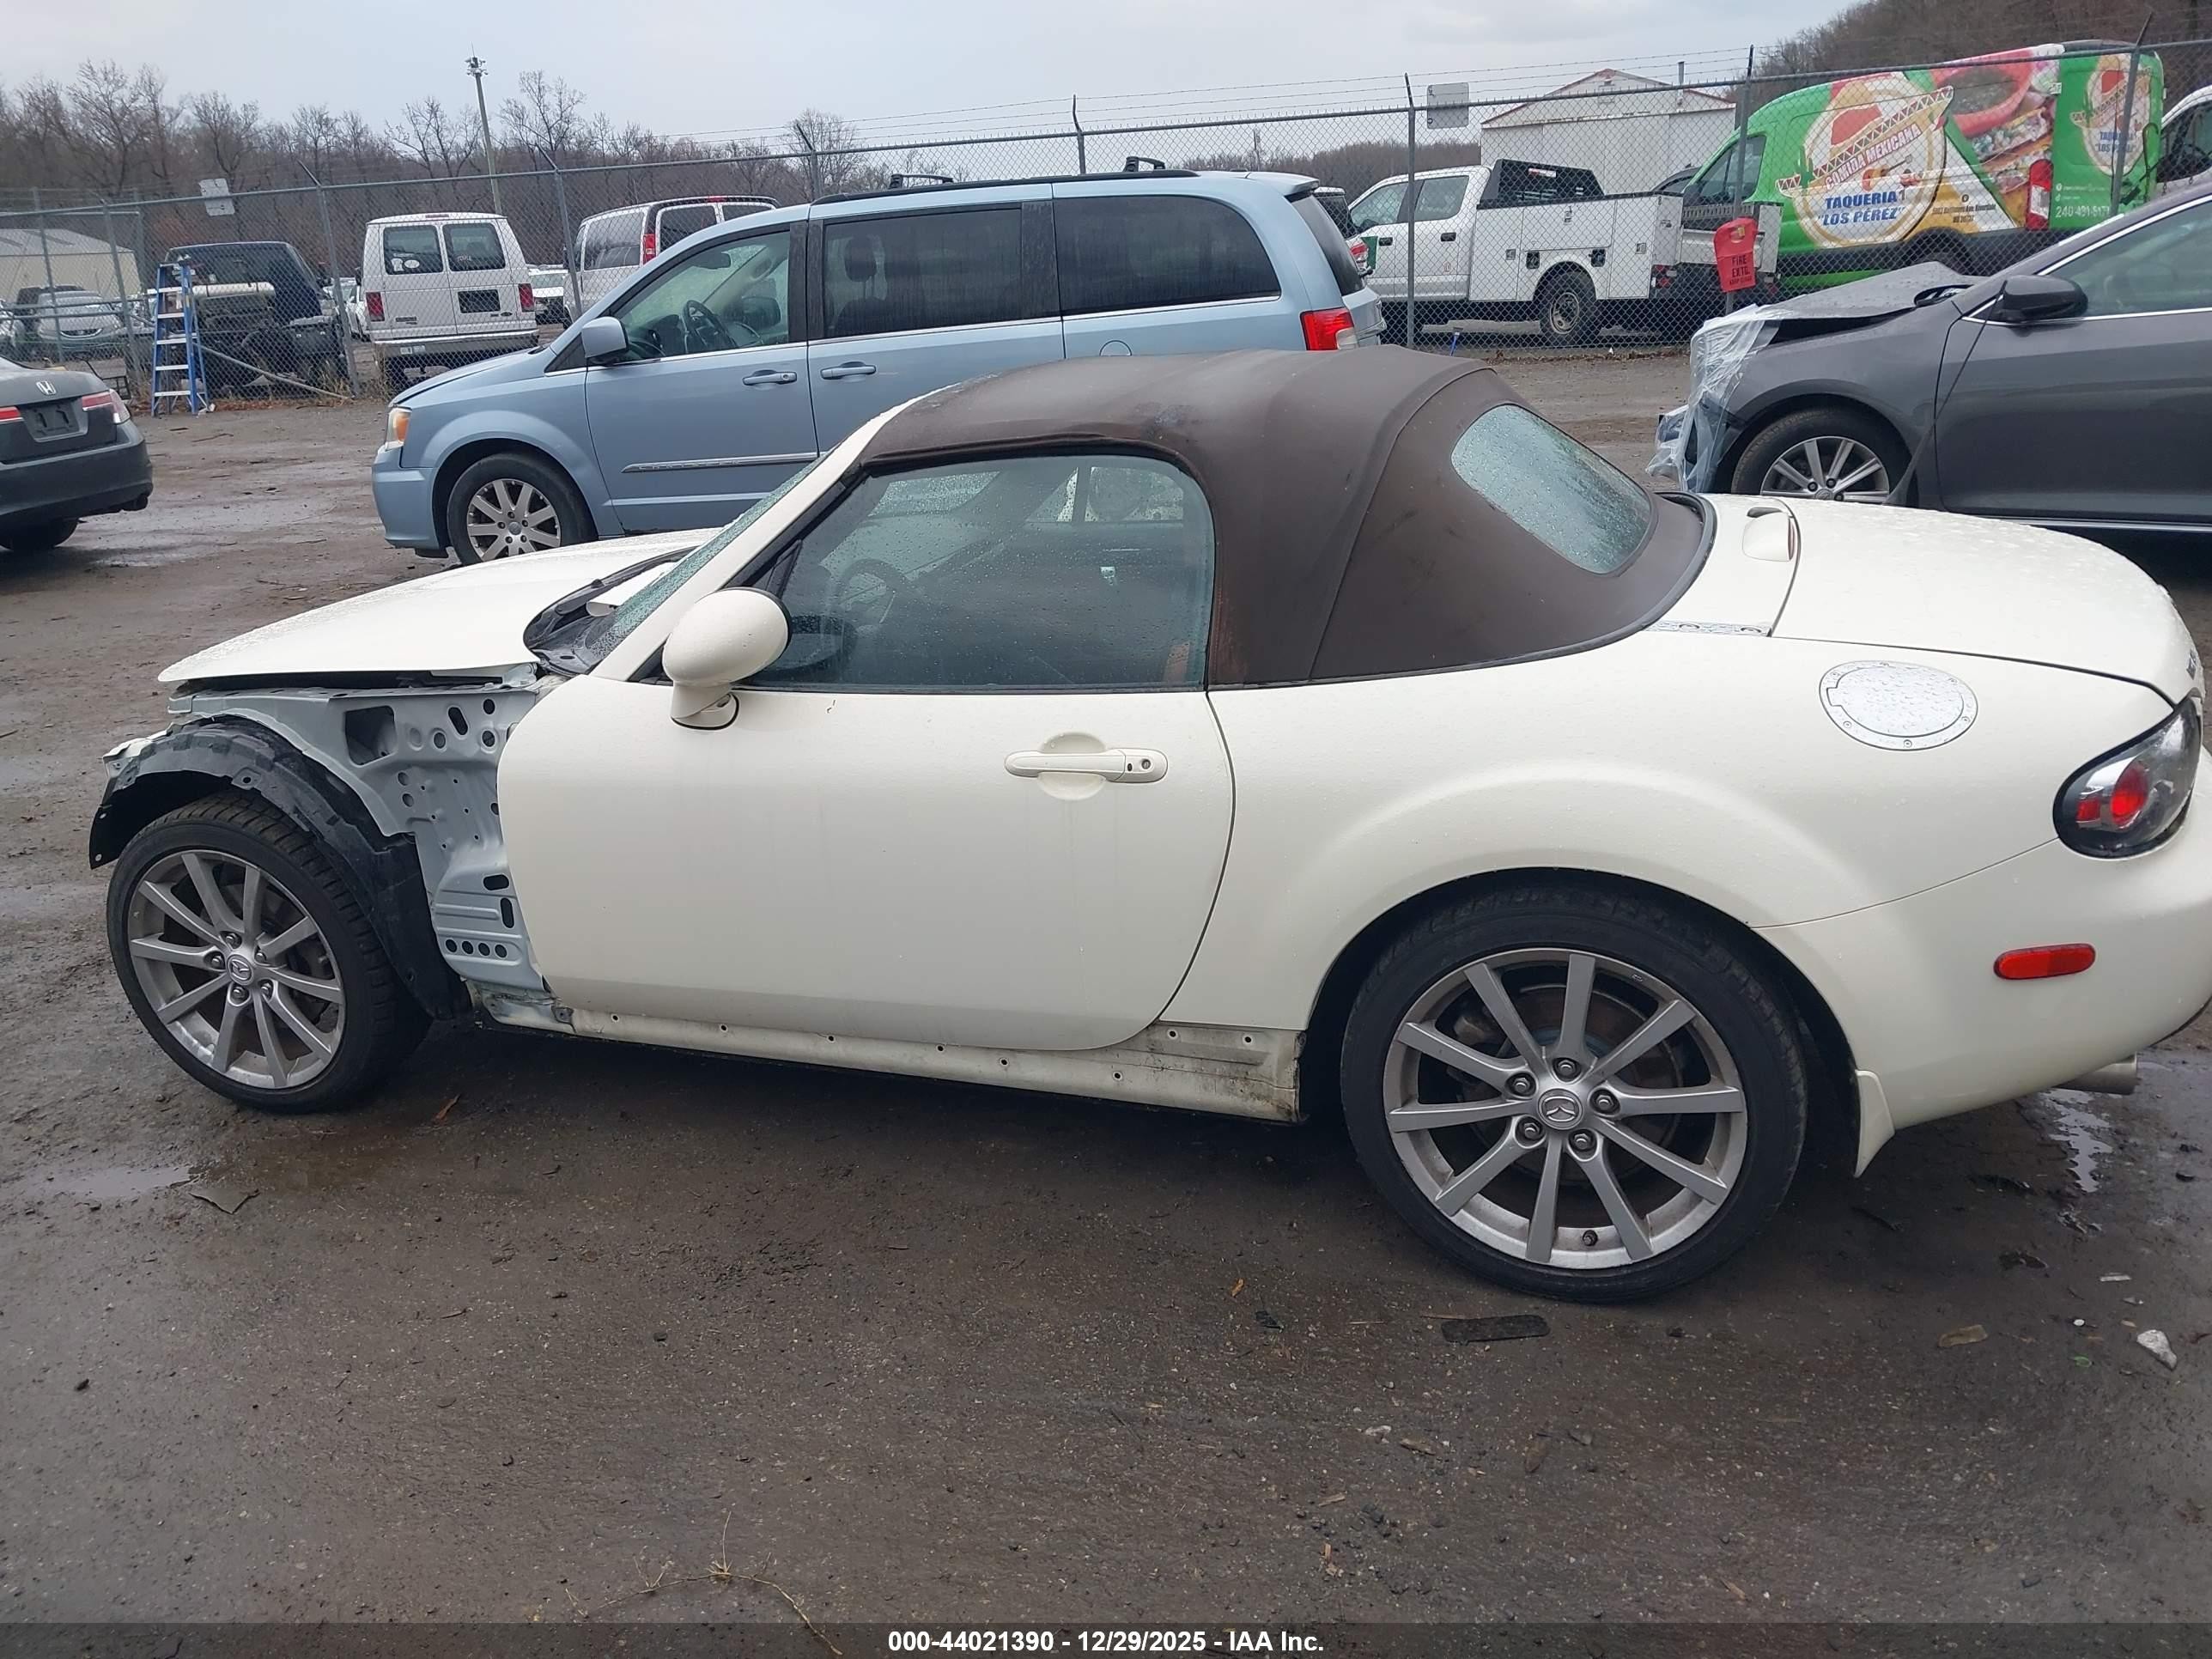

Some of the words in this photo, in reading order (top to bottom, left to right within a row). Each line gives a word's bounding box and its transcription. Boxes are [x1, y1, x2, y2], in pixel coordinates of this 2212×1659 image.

[1825, 153, 1867, 190] COMIDA
[1826, 191, 1897, 210] TAQUERIA
[1732, 254, 1747, 266] FIRE
